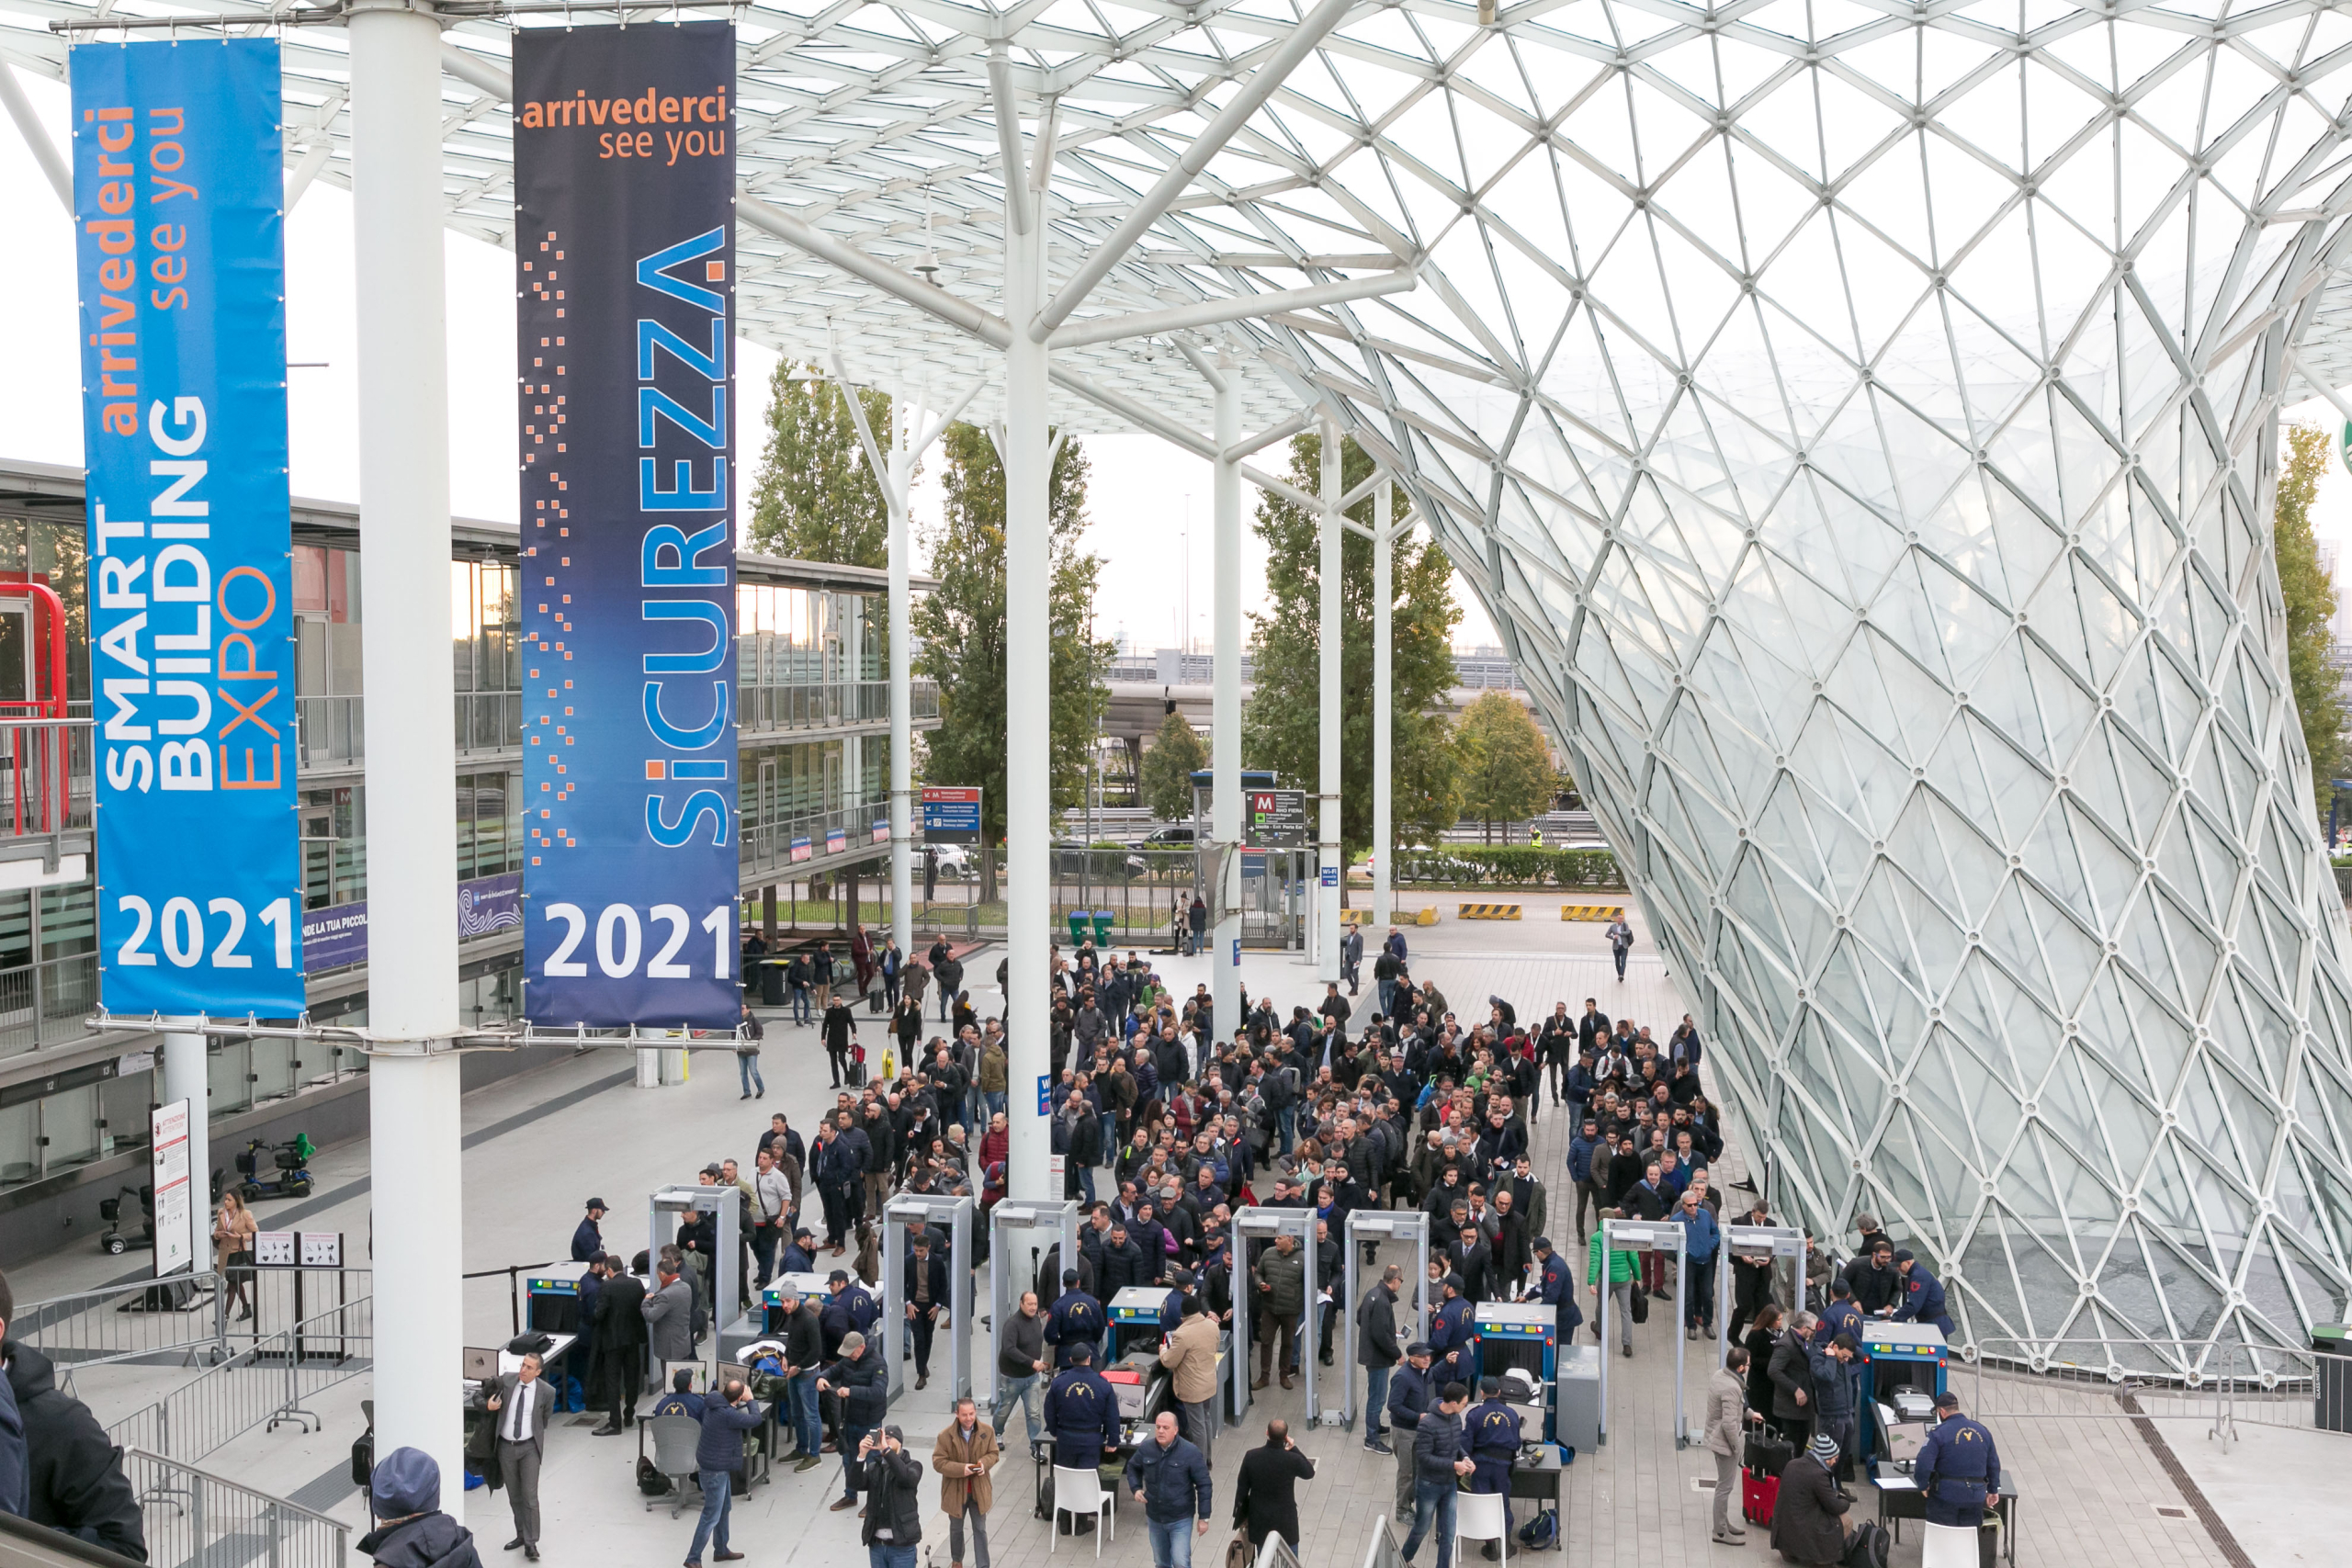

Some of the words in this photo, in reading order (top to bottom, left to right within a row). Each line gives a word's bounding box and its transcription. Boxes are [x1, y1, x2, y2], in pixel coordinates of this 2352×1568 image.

[522, 85, 727, 129] arrivederci
[150, 107, 198, 203] you
[599, 131, 653, 159] see
[665, 130, 725, 167] you
[85, 107, 139, 435] arrivederci
[152, 224, 187, 310] see
[149, 396, 213, 792] BUILDING
[95, 502, 153, 795] SMART
[218, 566, 281, 790] EXPO
[1257, 796, 1272, 810] M
[118, 895, 293, 969] 2021
[315, 921, 325, 934] LA
[326, 919, 341, 932] TUA
[342, 913, 368, 930] PICCOL
[544, 902, 730, 980] 2021
[46, 1080, 55, 1091] 12
[103, 1066, 110, 1076] 13
